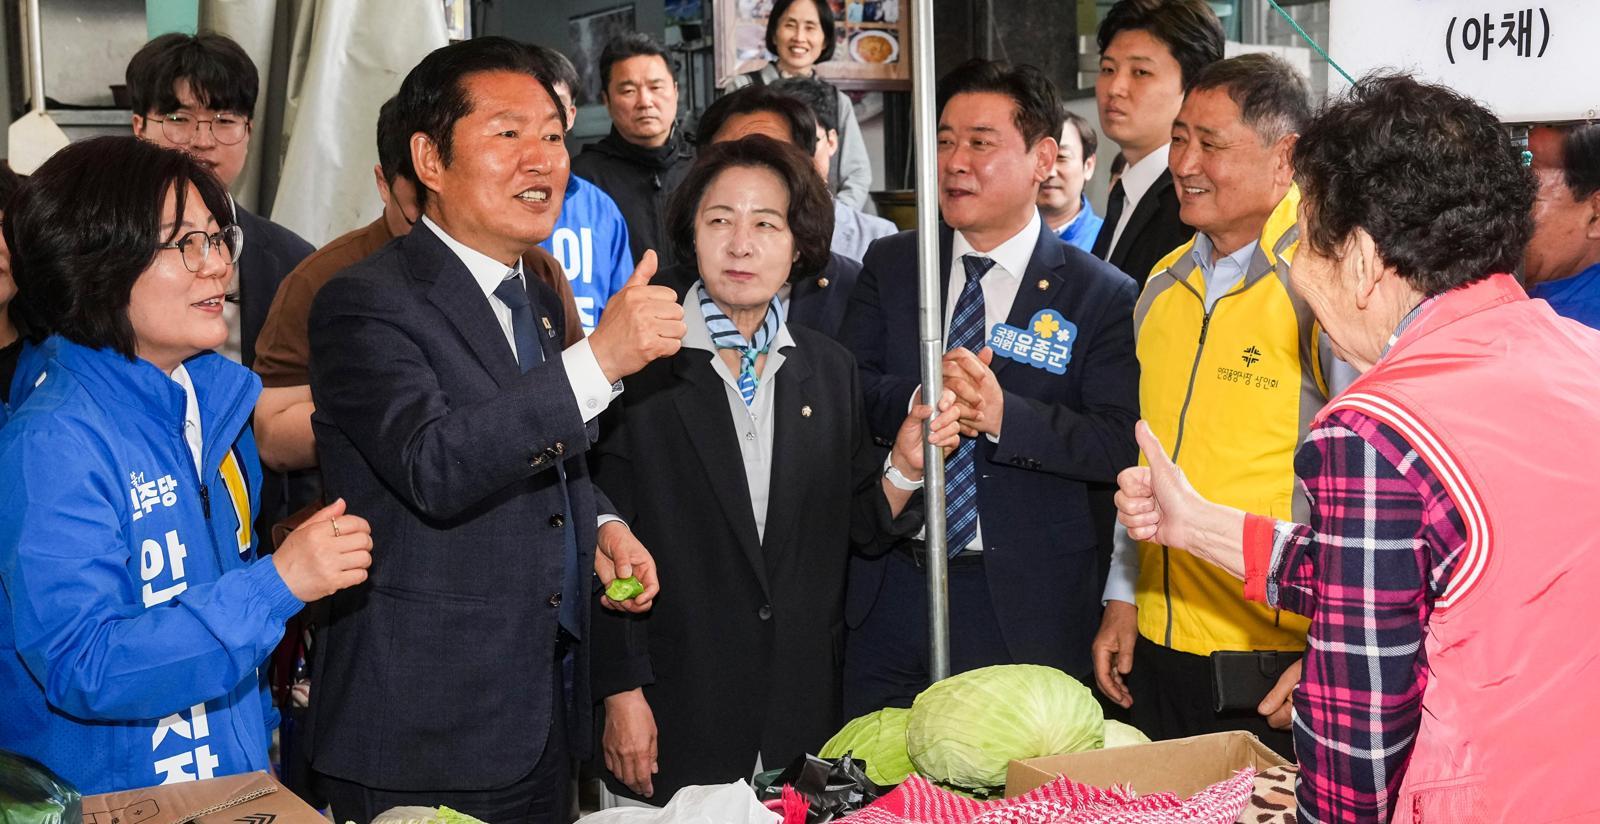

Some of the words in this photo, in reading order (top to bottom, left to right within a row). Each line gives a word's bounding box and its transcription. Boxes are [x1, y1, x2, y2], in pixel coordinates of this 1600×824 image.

[1446, 8, 1549, 64] (야채)
[996, 326, 1018, 341] 국회
[992, 335, 1014, 351] 의원
[1013, 333, 1068, 368] 윤종군
[1255, 375, 1279, 389] 상인회
